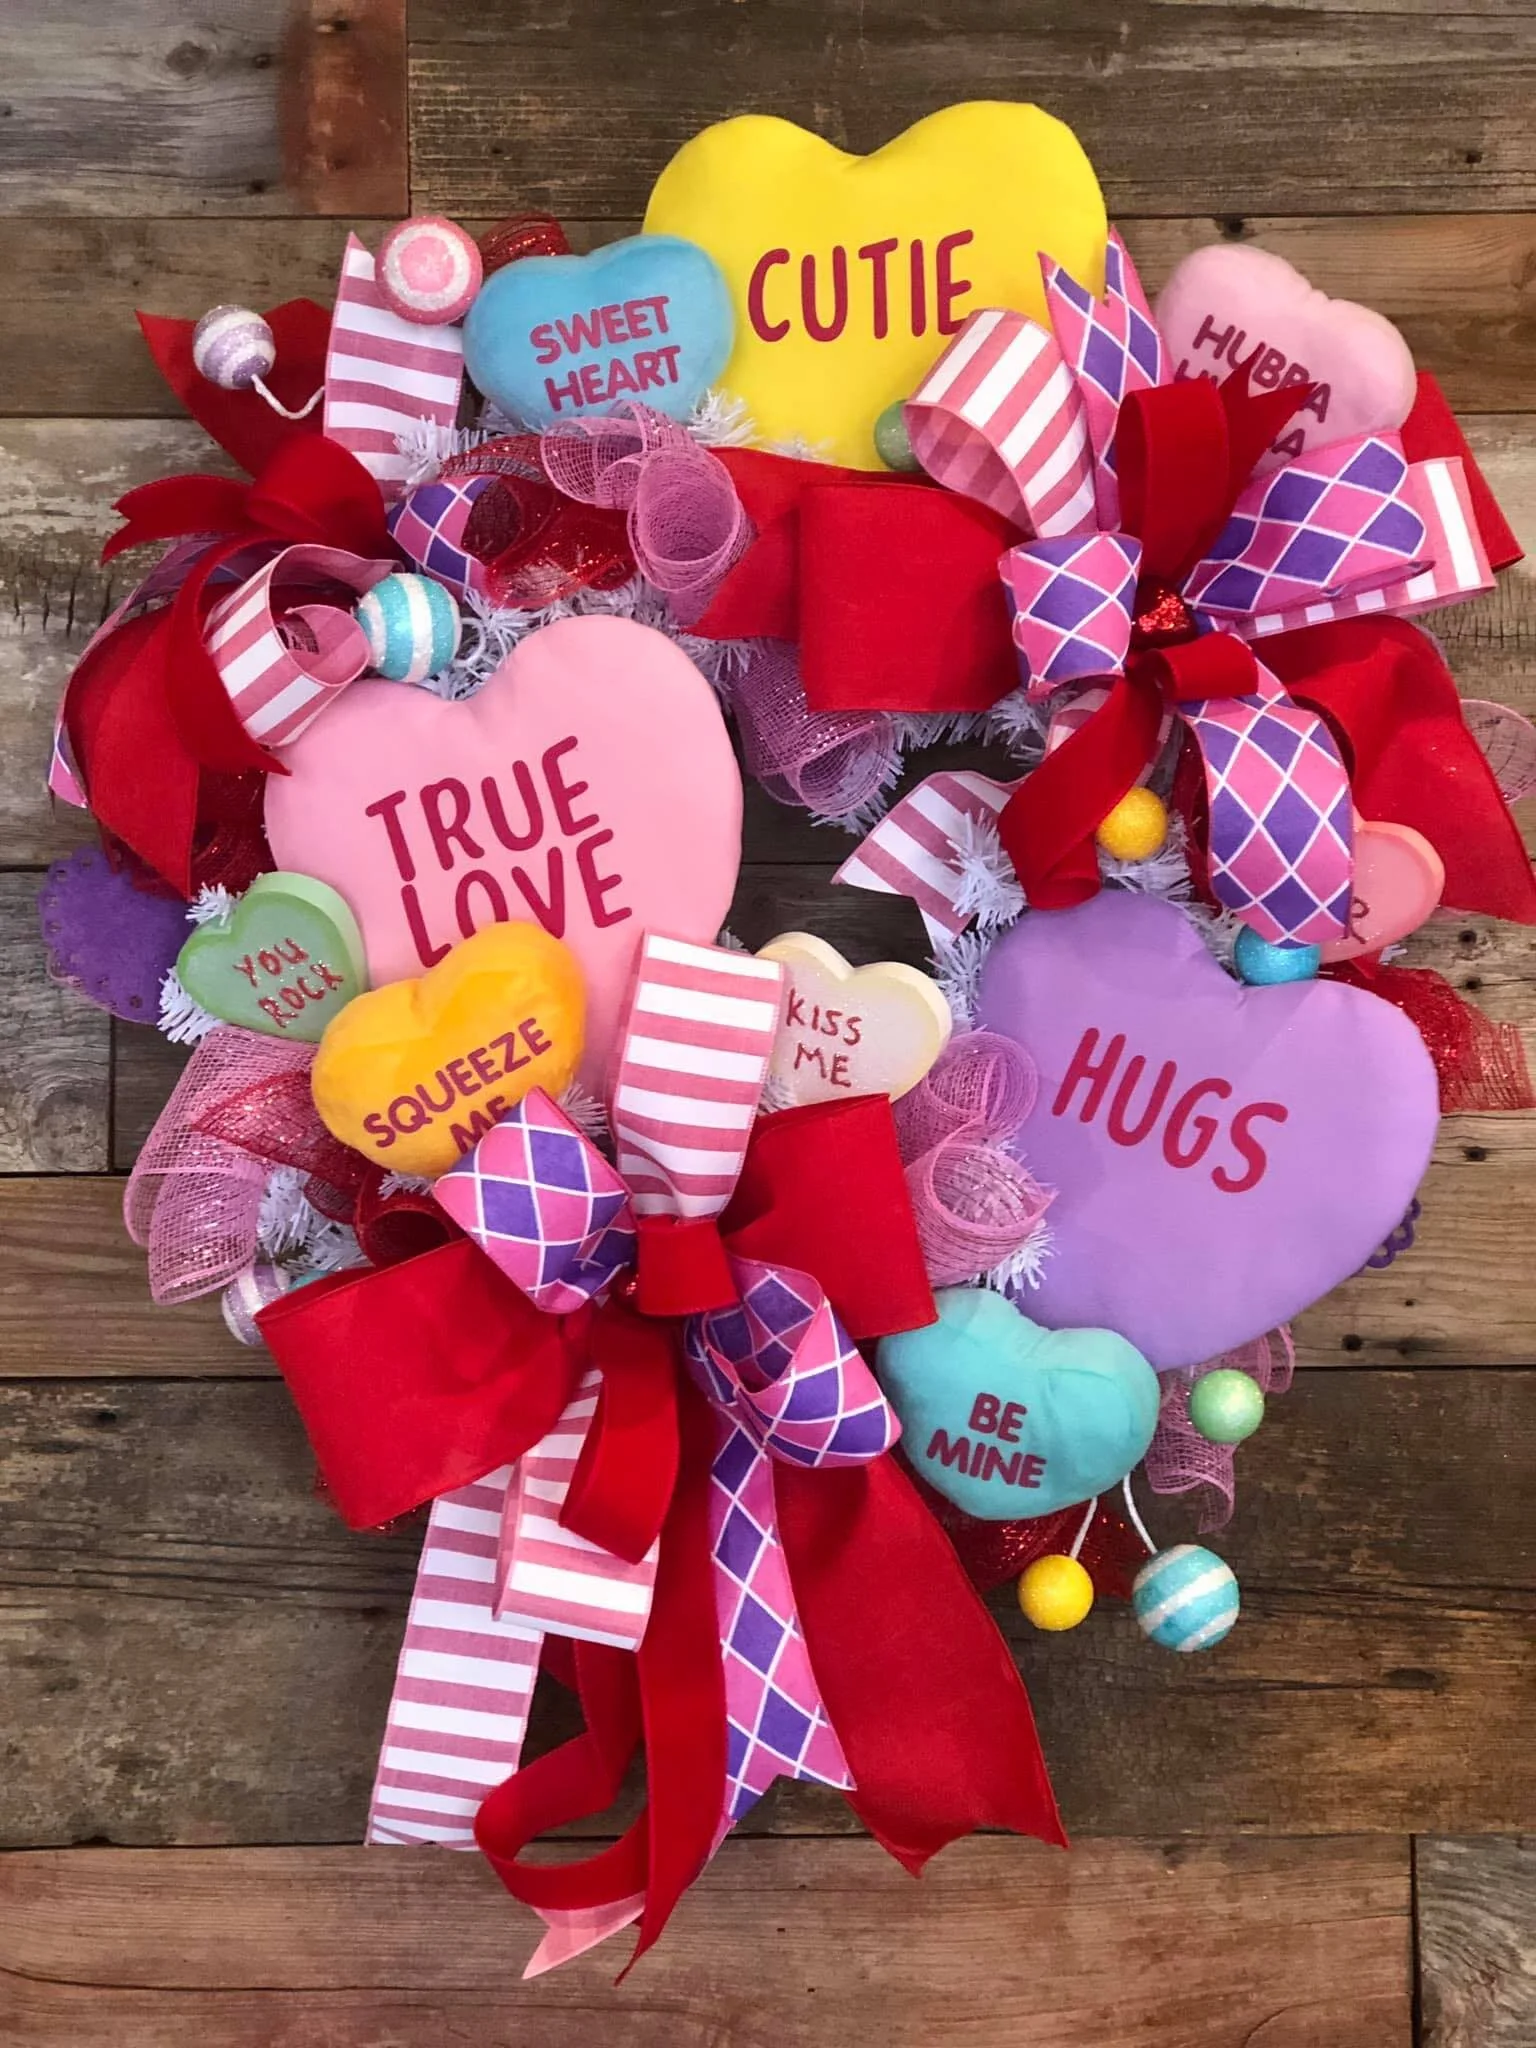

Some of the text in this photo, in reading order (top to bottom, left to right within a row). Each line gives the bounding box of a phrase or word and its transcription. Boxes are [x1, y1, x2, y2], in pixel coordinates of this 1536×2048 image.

[748, 229, 974, 342] CUTIE
[529, 295, 670, 364] SWEET
[544, 345, 682, 411] HEART
[365, 735, 600, 882] TRUE
[401, 828, 633, 968] LOVE
[232, 937, 309, 988] YOU
[257, 961, 344, 1029] ROCK
[786, 988, 863, 1046] KISS
[363, 1017, 553, 1148] SQUEEZE
[794, 1042, 852, 1088] ME
[1052, 1027, 1289, 1193] HUGS
[968, 1392, 1028, 1443] BE
[926, 1428, 1047, 1489] MINE
